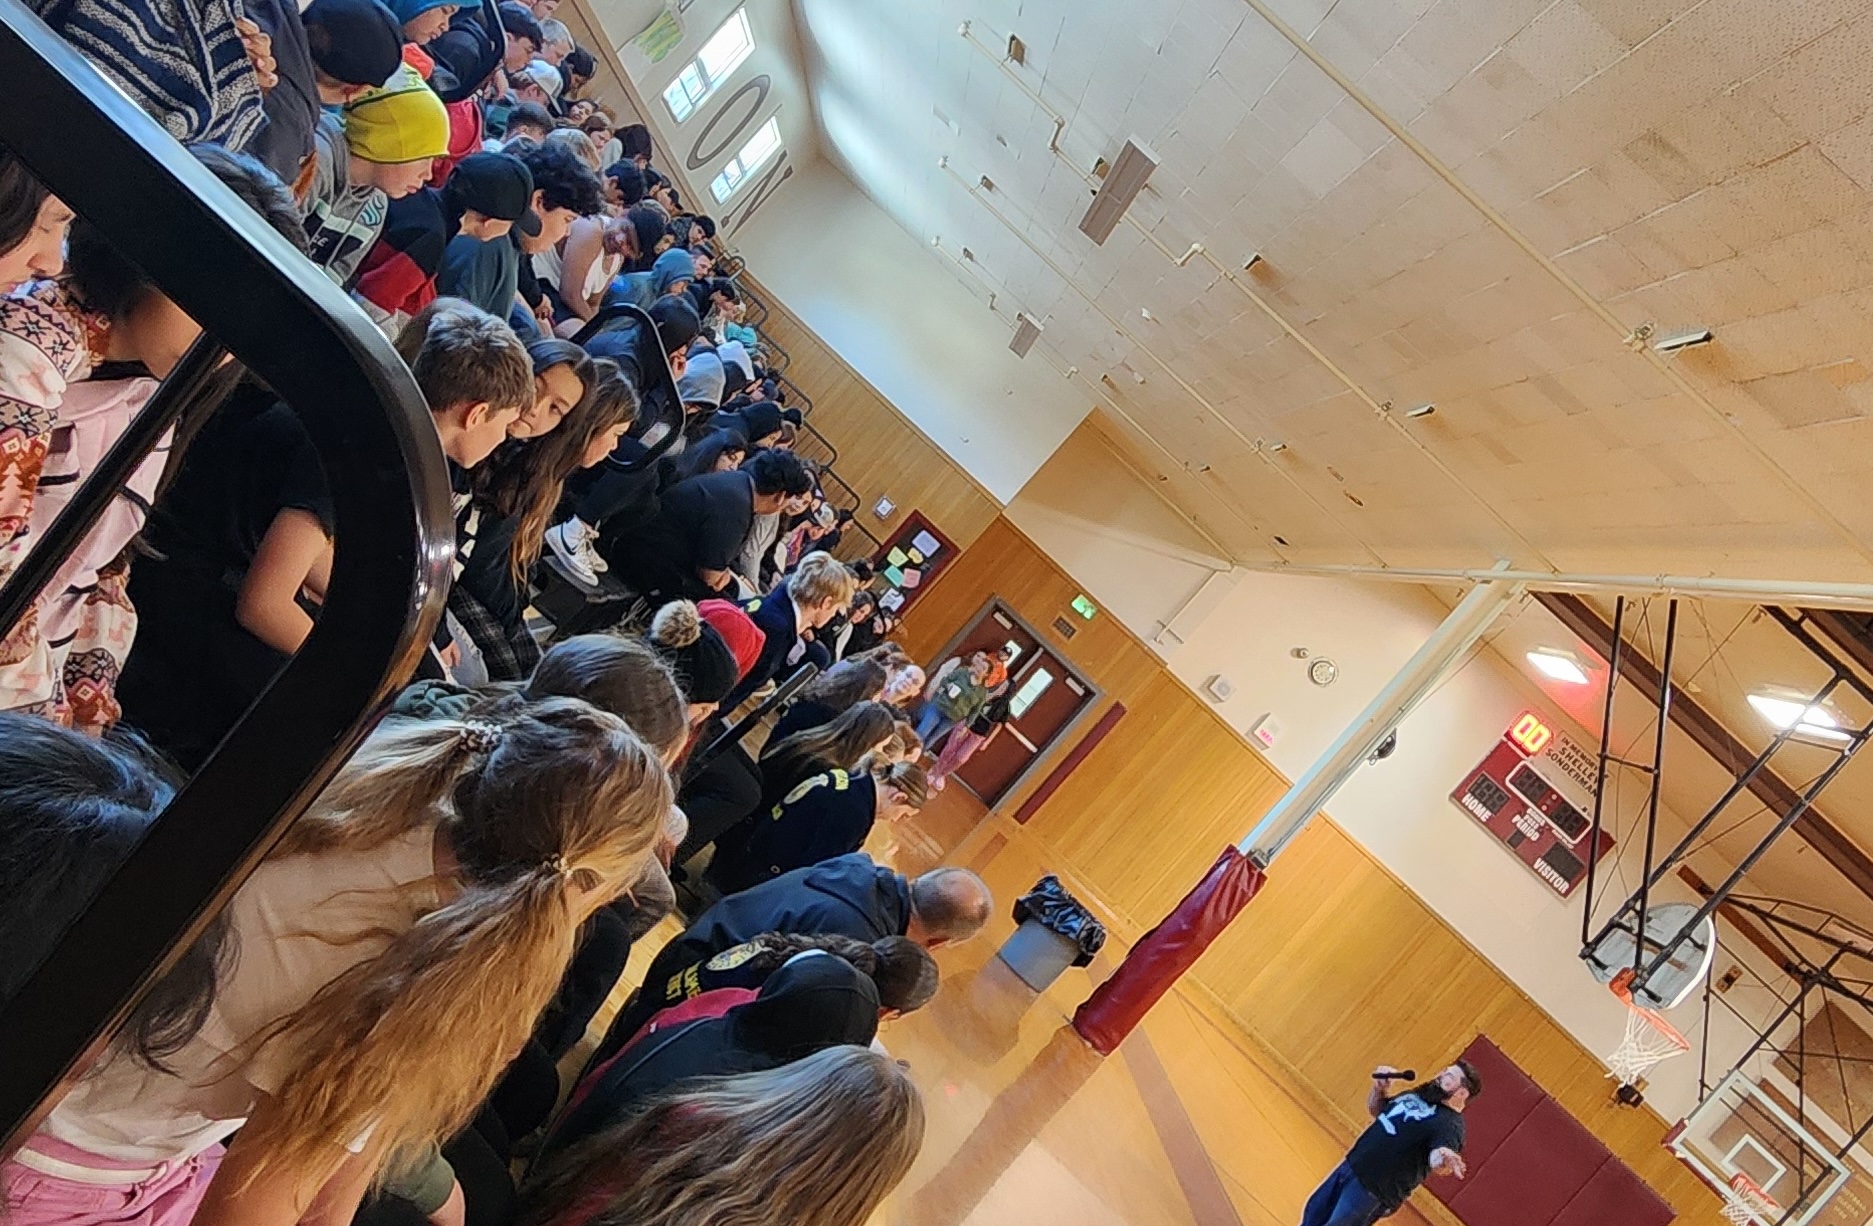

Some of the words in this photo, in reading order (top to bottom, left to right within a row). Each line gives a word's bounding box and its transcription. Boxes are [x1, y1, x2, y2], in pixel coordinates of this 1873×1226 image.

[1461, 793, 1493, 823] HOME
[1511, 814, 1540, 842] PERIOD
[1533, 857, 1570, 894] VISITOR
